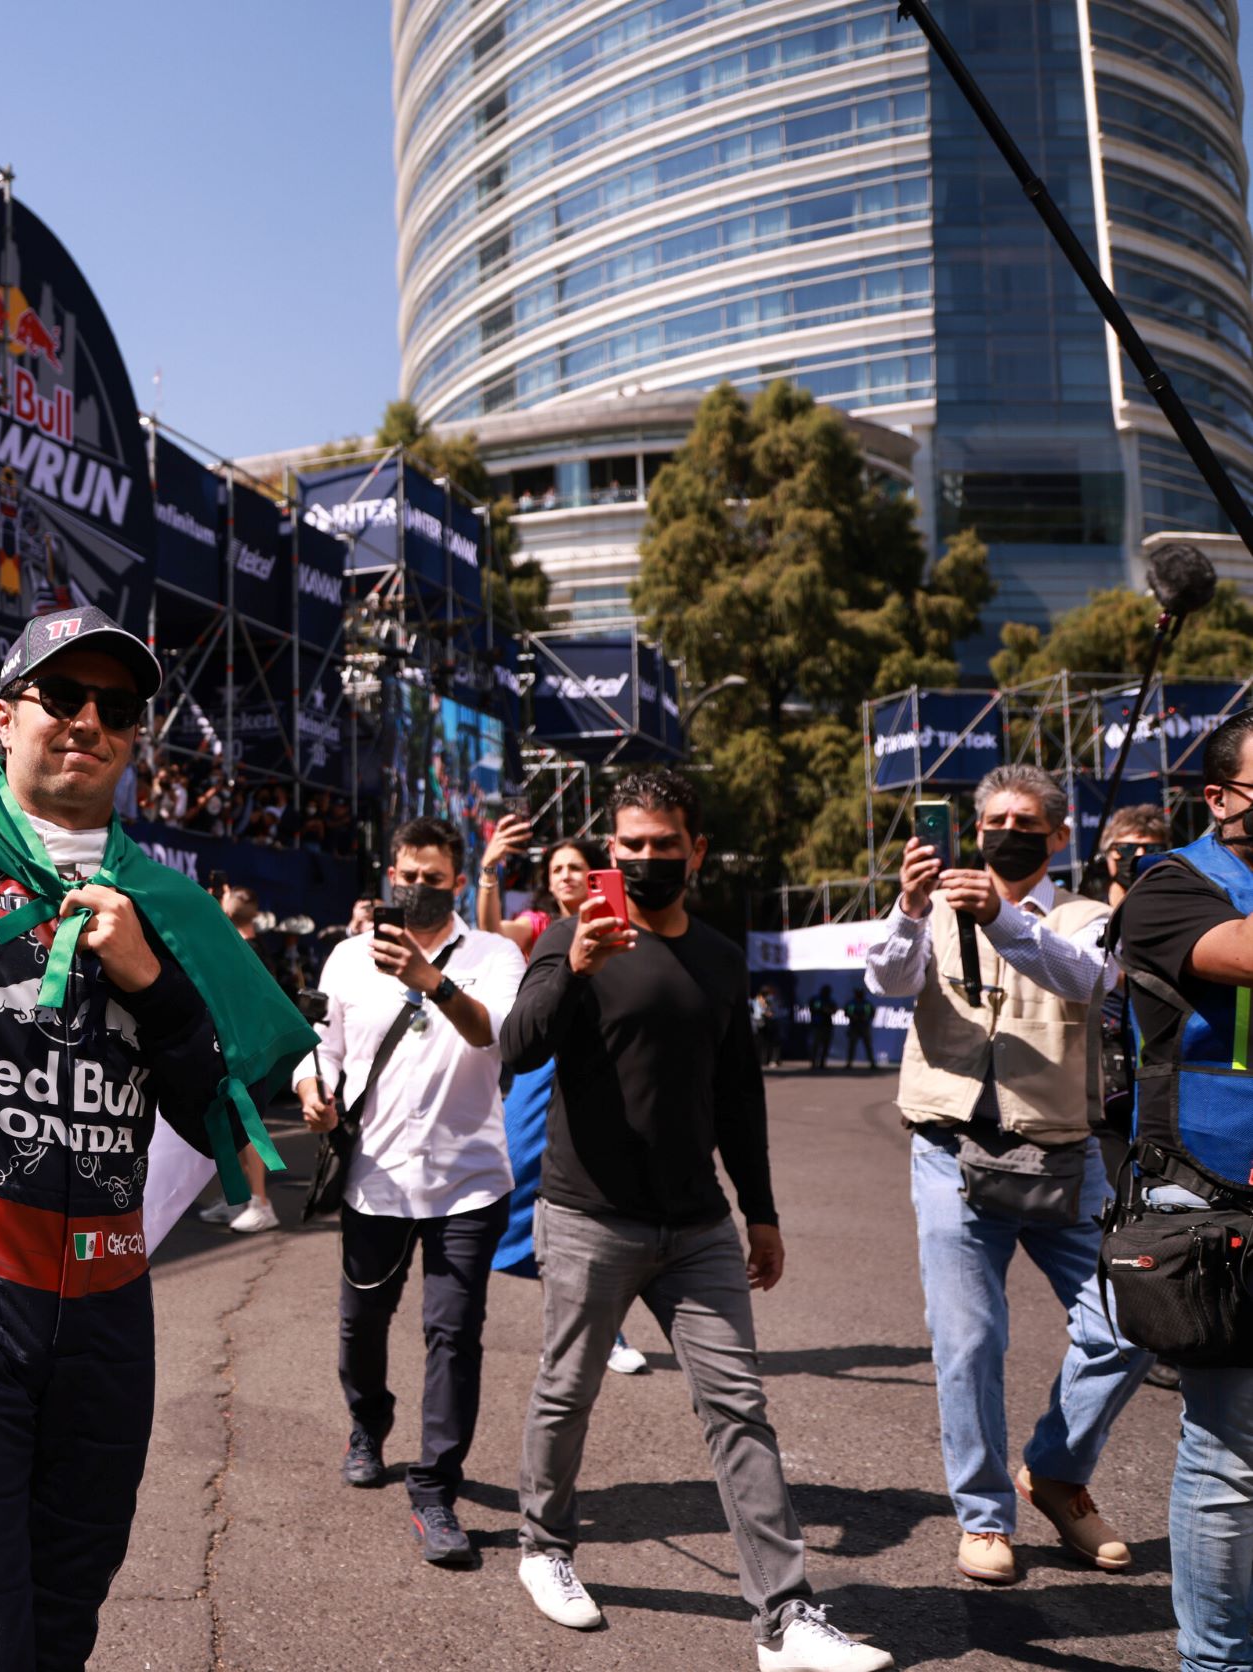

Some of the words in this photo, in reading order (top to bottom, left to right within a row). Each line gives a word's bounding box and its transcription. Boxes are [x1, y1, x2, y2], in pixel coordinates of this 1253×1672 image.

[14, 363, 75, 446] Bull
[236, 545, 276, 581] telcel
[46, 618, 92, 640] 11
[73, 1058, 150, 1118] Bull
